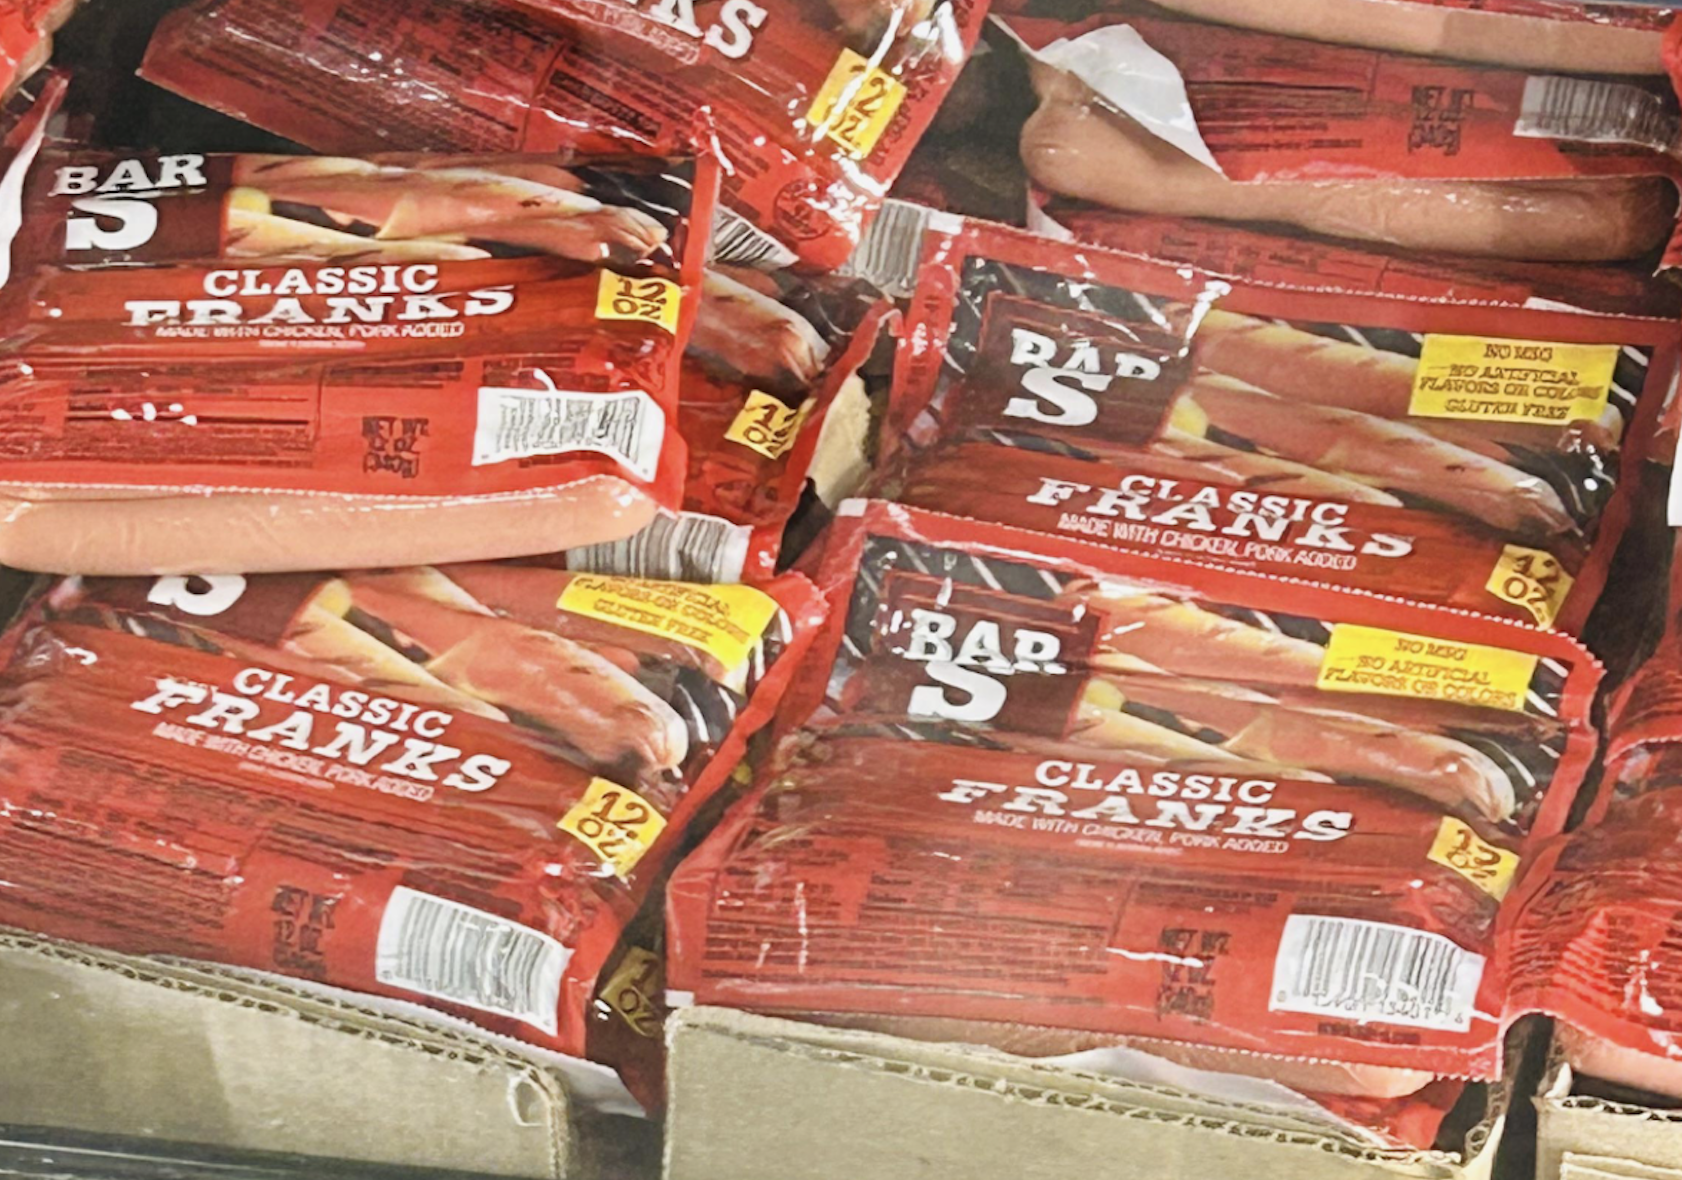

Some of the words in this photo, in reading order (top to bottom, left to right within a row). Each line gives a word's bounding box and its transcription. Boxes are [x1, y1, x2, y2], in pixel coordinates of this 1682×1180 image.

[48, 154, 207, 197] BAR
[203, 264, 440, 297] CLASSIC
[616, 276, 667, 305] 12
[121, 284, 515, 326] FRANKS
[1003, 367, 1113, 426] S
[1026, 478, 1418, 559] FRANKS
[1120, 475, 1348, 526] CLASSIC
[1057, 512, 1110, 537] MADE
[1512, 554, 1562, 596] 12
[903, 608, 1067, 675] BAR
[907, 660, 1007, 722] S
[1389, 660, 1490, 686] ARTIFICIAL
[233, 667, 453, 738] CLASSIC
[1442, 684, 1517, 709] COLORS
[130, 677, 512, 792] FRANKS
[1035, 759, 1277, 804] CLASSIC
[591, 791, 649, 838] 12
[937, 778, 1353, 842] FRANKS
[974, 810, 1025, 830] MADE
[1032, 815, 1079, 833] WITH
[1222, 835, 1289, 854] ADDED
[1452, 829, 1501, 868] 12
